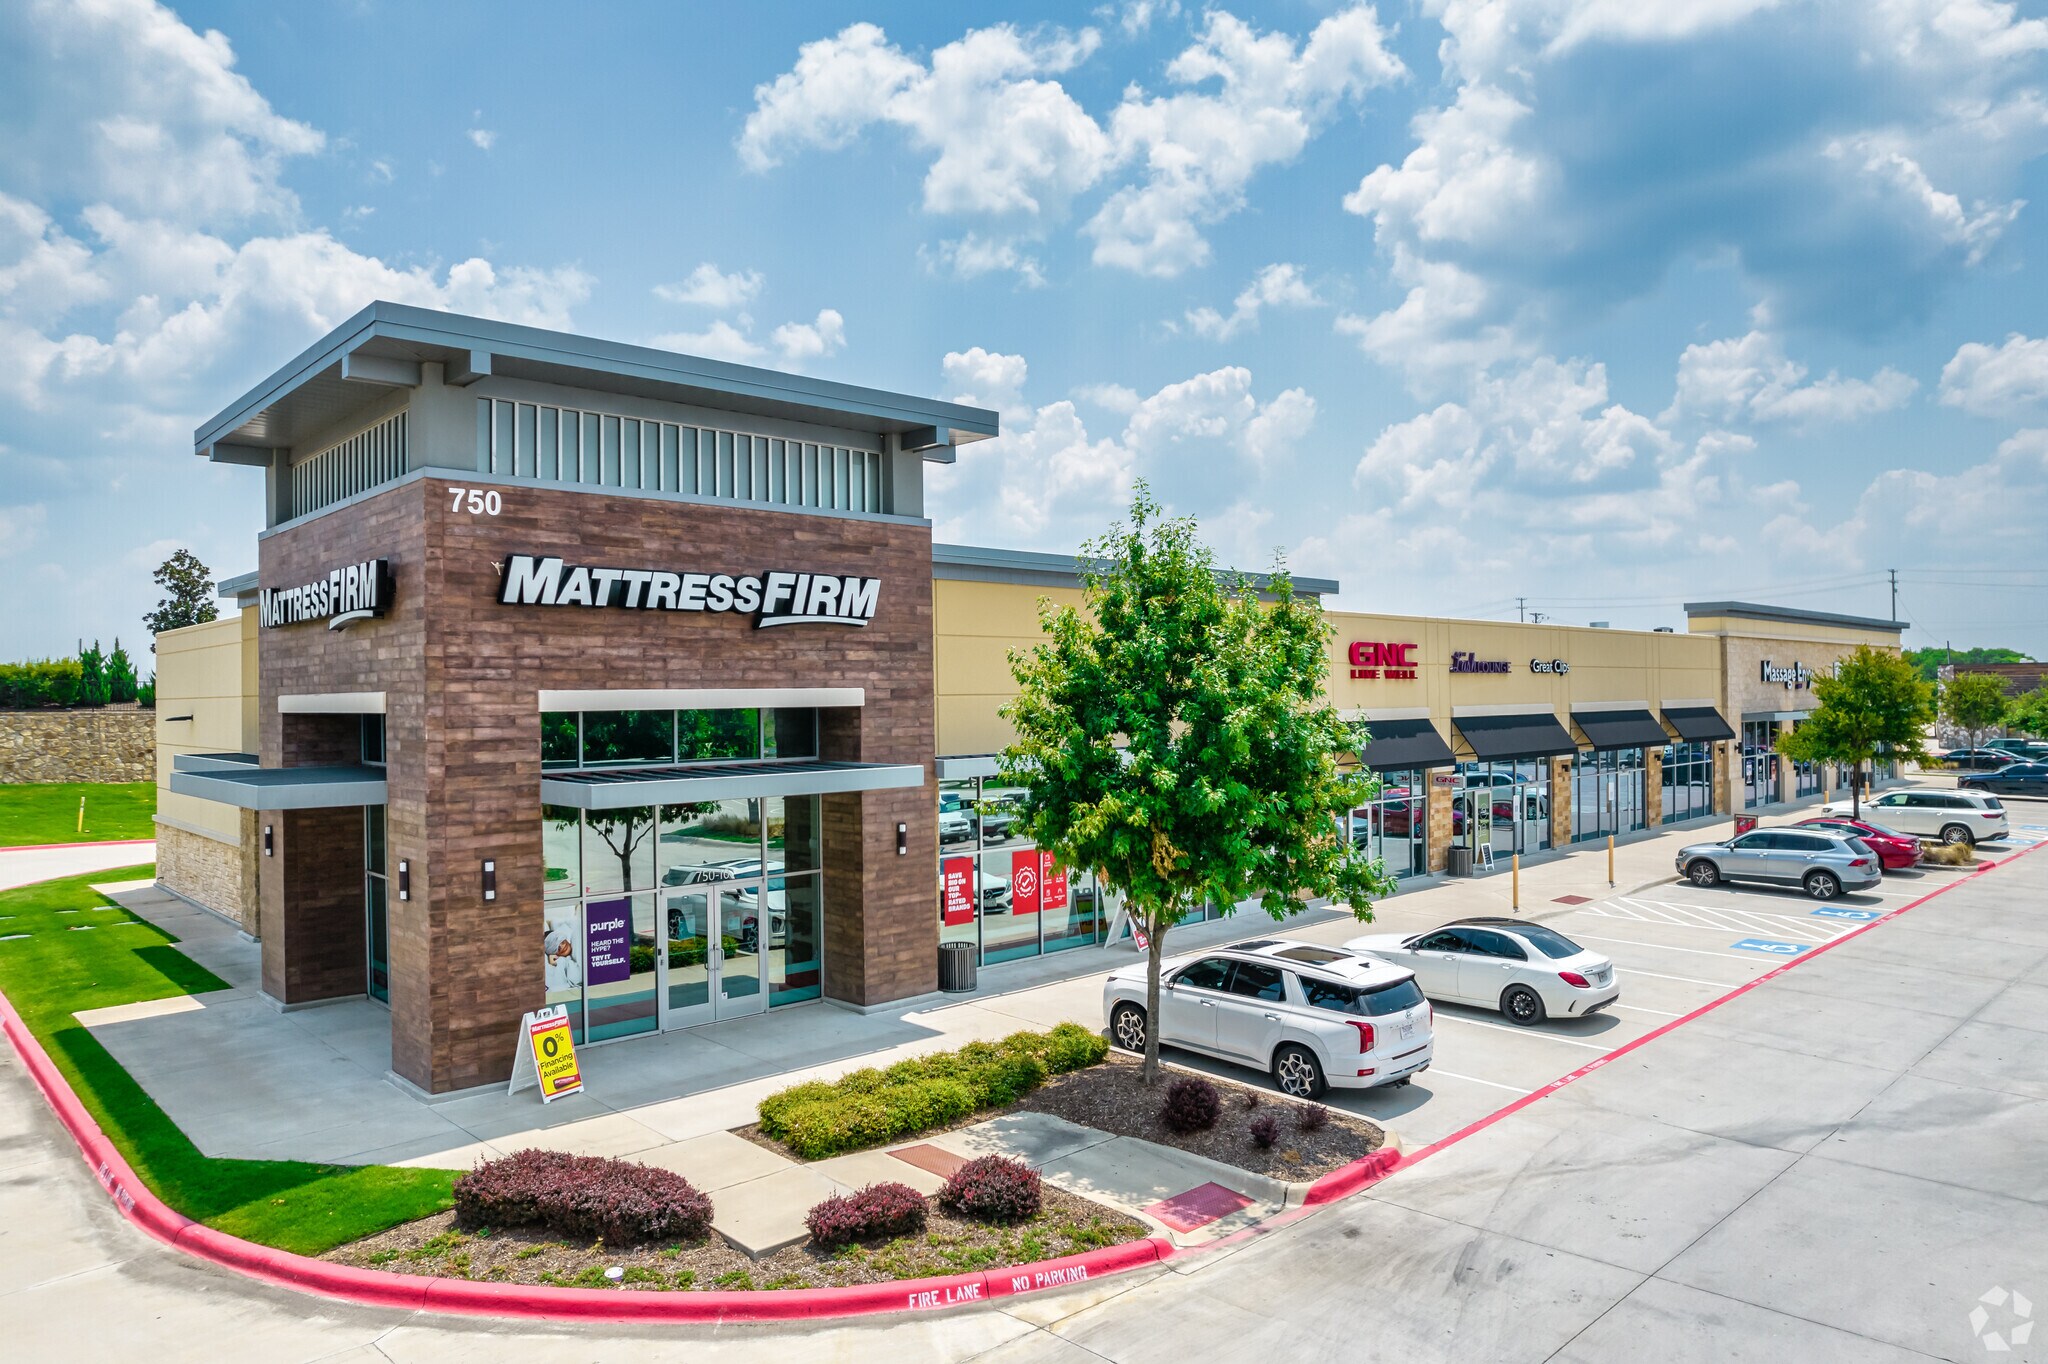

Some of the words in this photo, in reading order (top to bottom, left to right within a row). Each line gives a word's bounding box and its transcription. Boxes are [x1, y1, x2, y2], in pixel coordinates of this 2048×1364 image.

[448, 488, 502, 516] 750
[1349, 641, 1418, 667] GNC
[1531, 659, 1553, 673] Great
[1553, 659, 1571, 676] Clips
[1350, 670, 1380, 680] LIVE
[1384, 670, 1418, 680] WELL
[1761, 660, 1796, 689] Massage
[1435, 776, 1460, 784] GNC
[948, 872, 962, 880] SAVE
[948, 898, 966, 906] RATED
[948, 903, 971, 912] BRANDS
[590, 918, 625, 934] purple
[591, 939, 612, 948] HEARD
[591, 945, 610, 953] HYPE?
[591, 954, 604, 962] TRY
[591, 957, 626, 968] YOURSELF.
[540, 1053, 574, 1070] Financing
[543, 1062, 574, 1079] Available
[908, 1290, 941, 1309] FIRE
[946, 1283, 981, 1303] LANE
[1012, 1275, 1030, 1292] NO
[1036, 1265, 1088, 1287] PARKING
